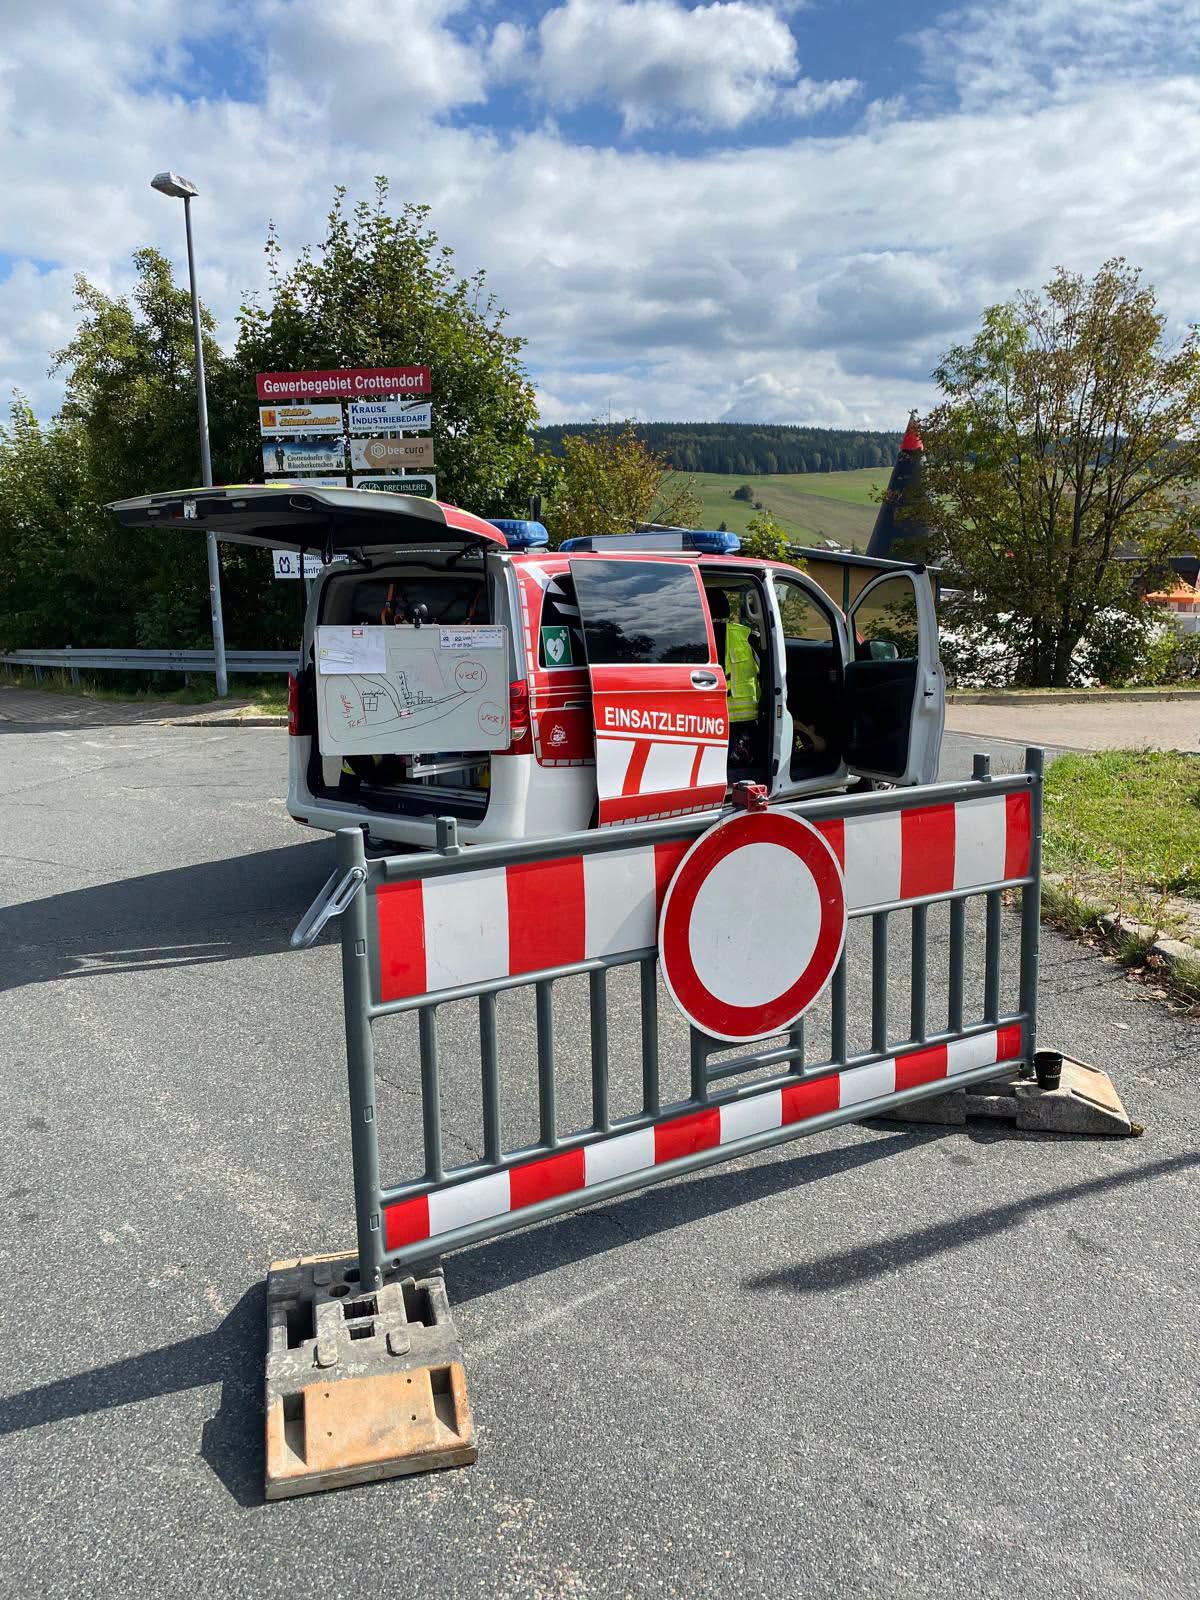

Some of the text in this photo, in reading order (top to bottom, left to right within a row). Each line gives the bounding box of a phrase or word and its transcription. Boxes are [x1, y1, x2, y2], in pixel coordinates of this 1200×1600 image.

[263, 373, 424, 394] Gewerbegebiet Crottendorf
[383, 483, 427, 492] DRECHSLEREI
[604, 706, 725, 735] EINSATZLEITUNG
